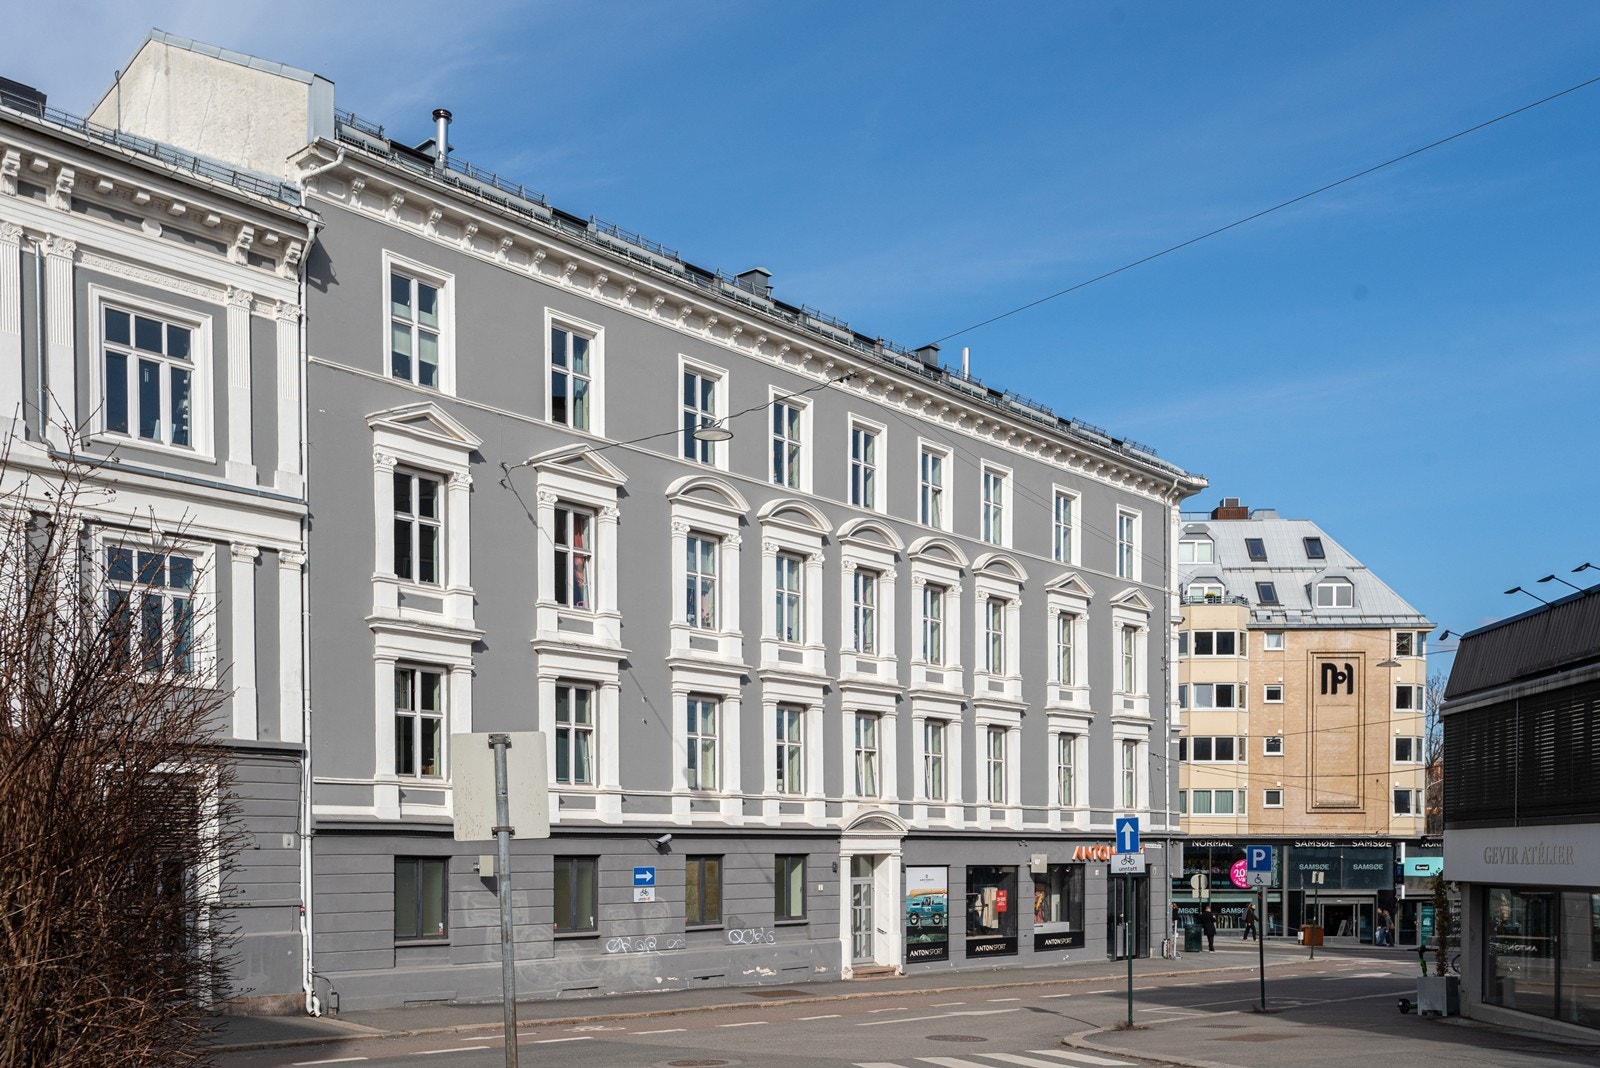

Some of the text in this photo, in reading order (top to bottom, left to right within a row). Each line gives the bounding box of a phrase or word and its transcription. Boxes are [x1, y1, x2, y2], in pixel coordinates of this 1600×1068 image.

[1484, 841, 1575, 865] GEVIR ATÉLIER
[1252, 849, 1266, 868] P
[1044, 937, 1073, 946] ANTONSPORT
[909, 947, 943, 957] ANTONSPORT
[975, 943, 1007, 952] ANTONSPORT
